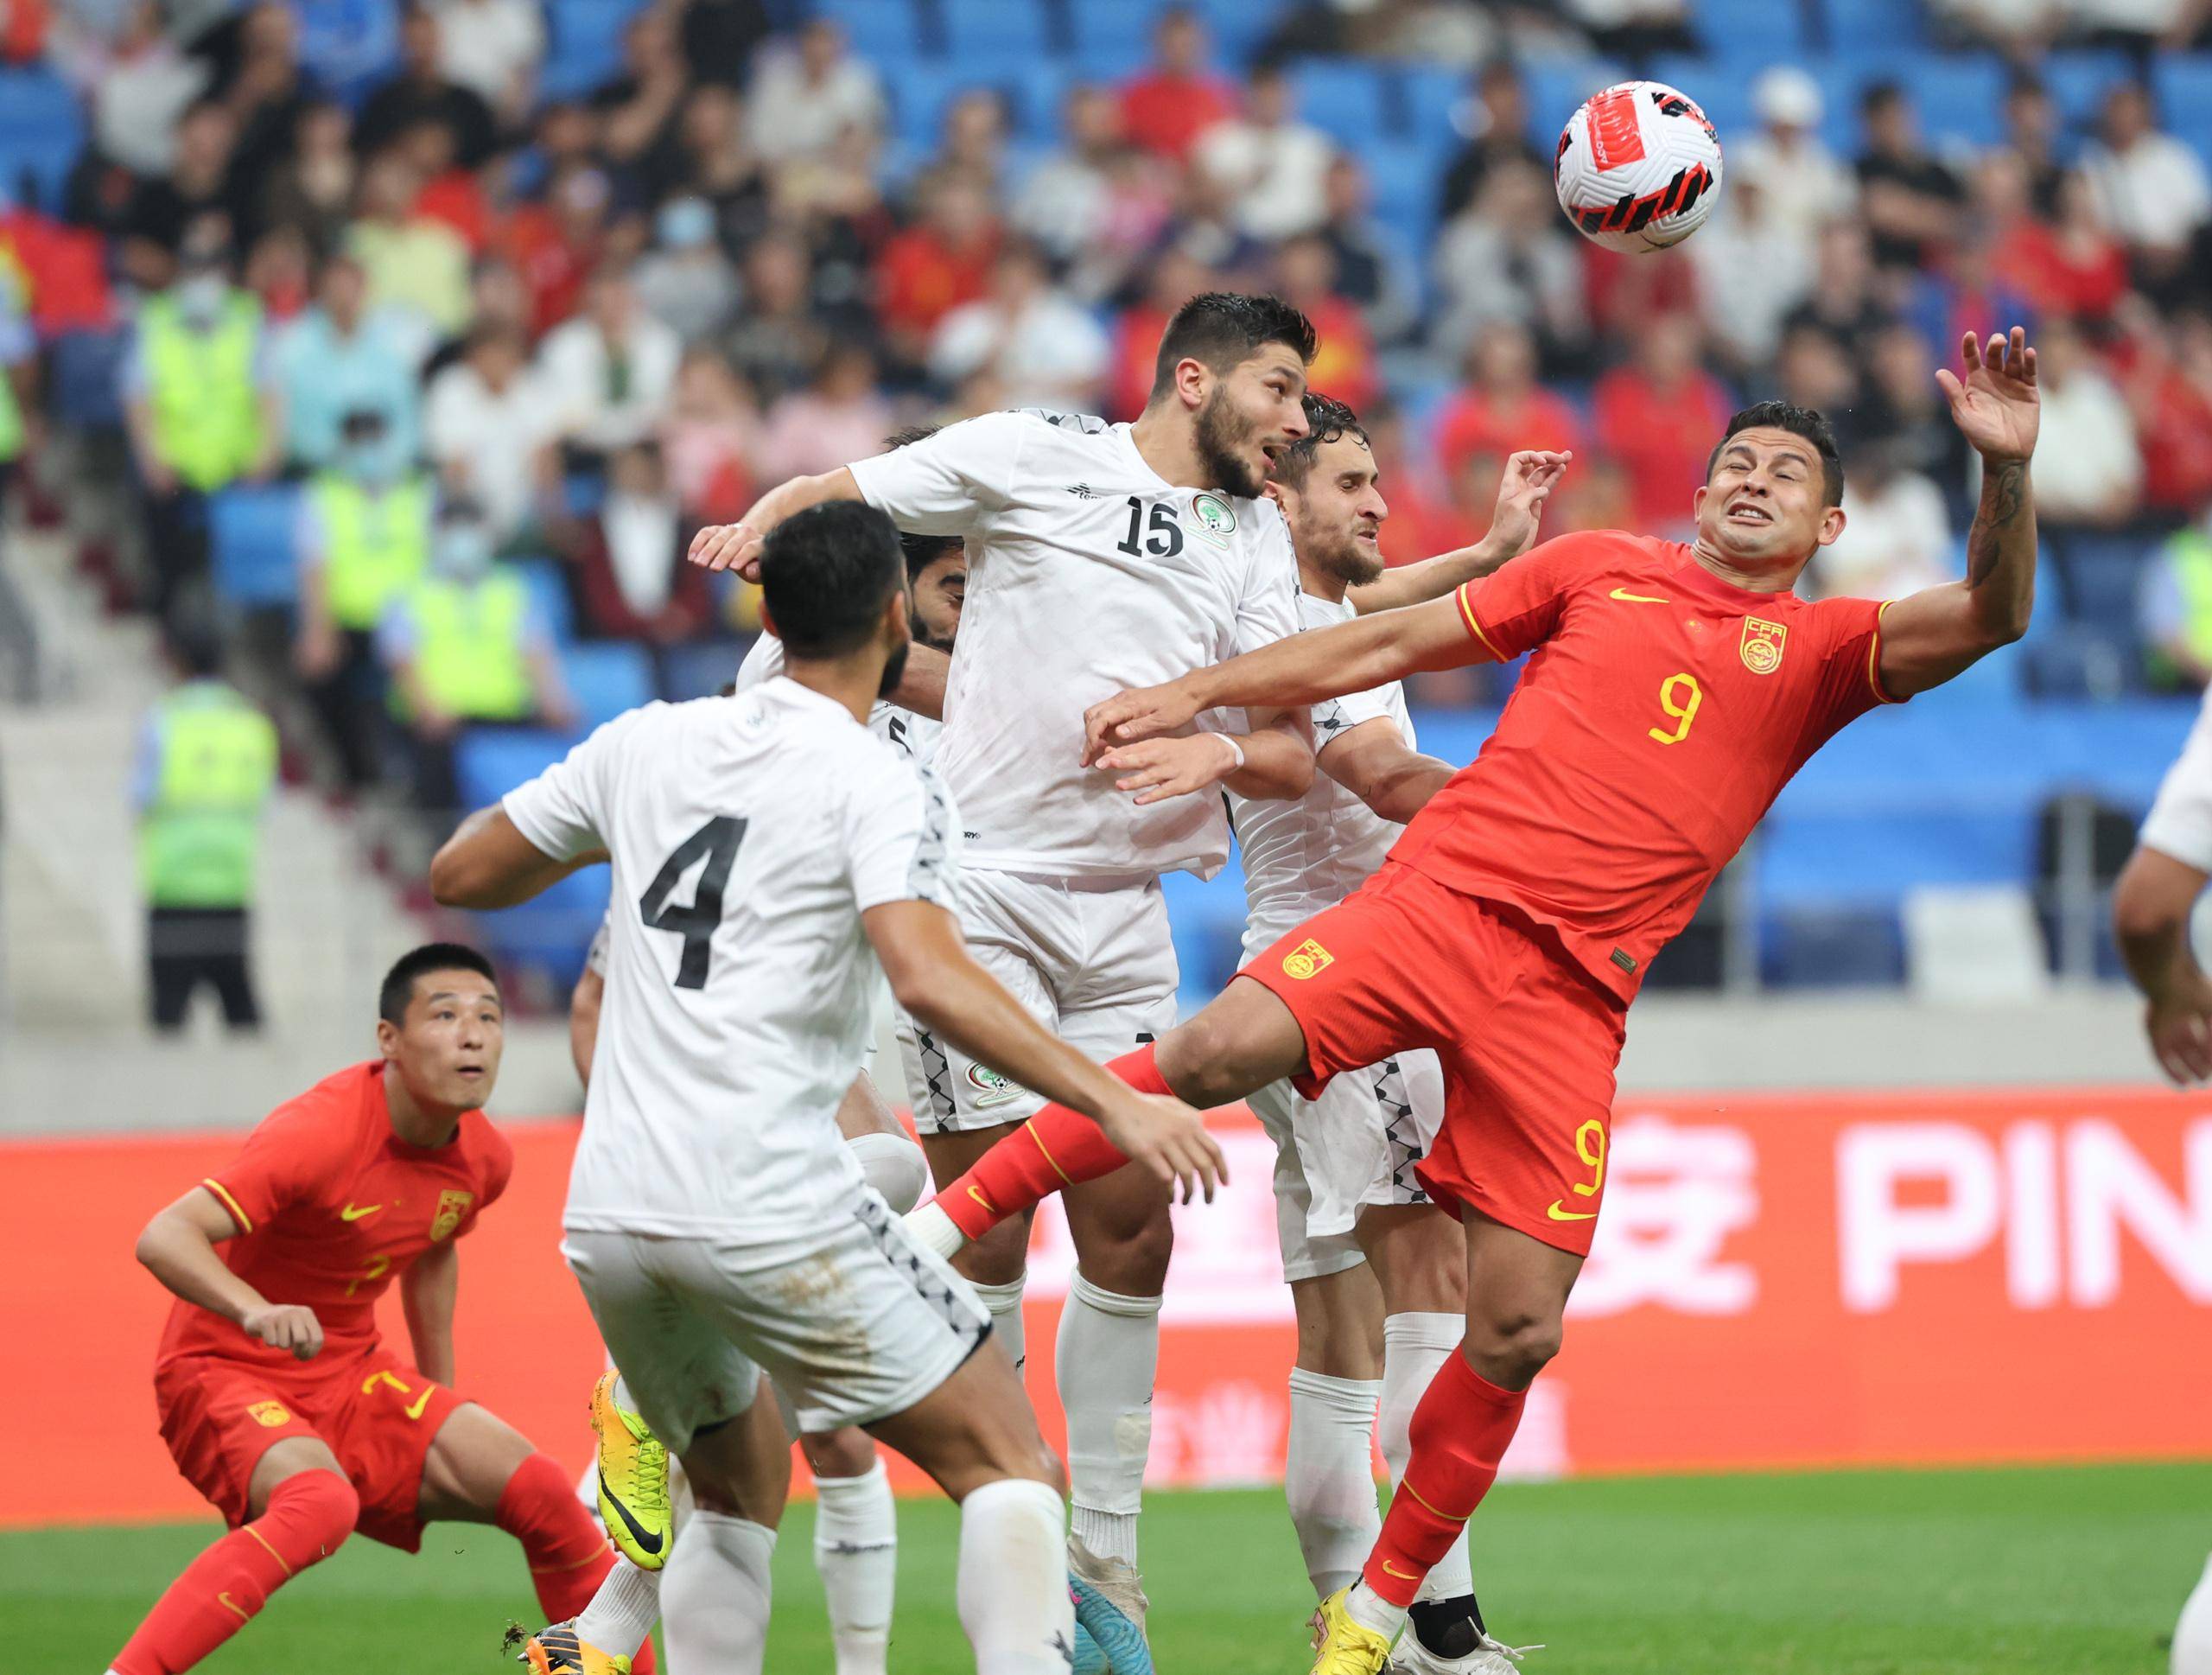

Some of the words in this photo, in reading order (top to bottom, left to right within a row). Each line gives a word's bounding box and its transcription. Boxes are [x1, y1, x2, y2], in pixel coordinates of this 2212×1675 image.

[1117, 496, 1184, 557] 15
[1748, 620, 1783, 637] CFA
[1648, 672, 1703, 745] 9
[639, 816, 748, 990] 4
[1573, 1118, 1605, 1197] 9
[1834, 1118, 2212, 1315] PIN
[361, 1370, 411, 1395] 7
